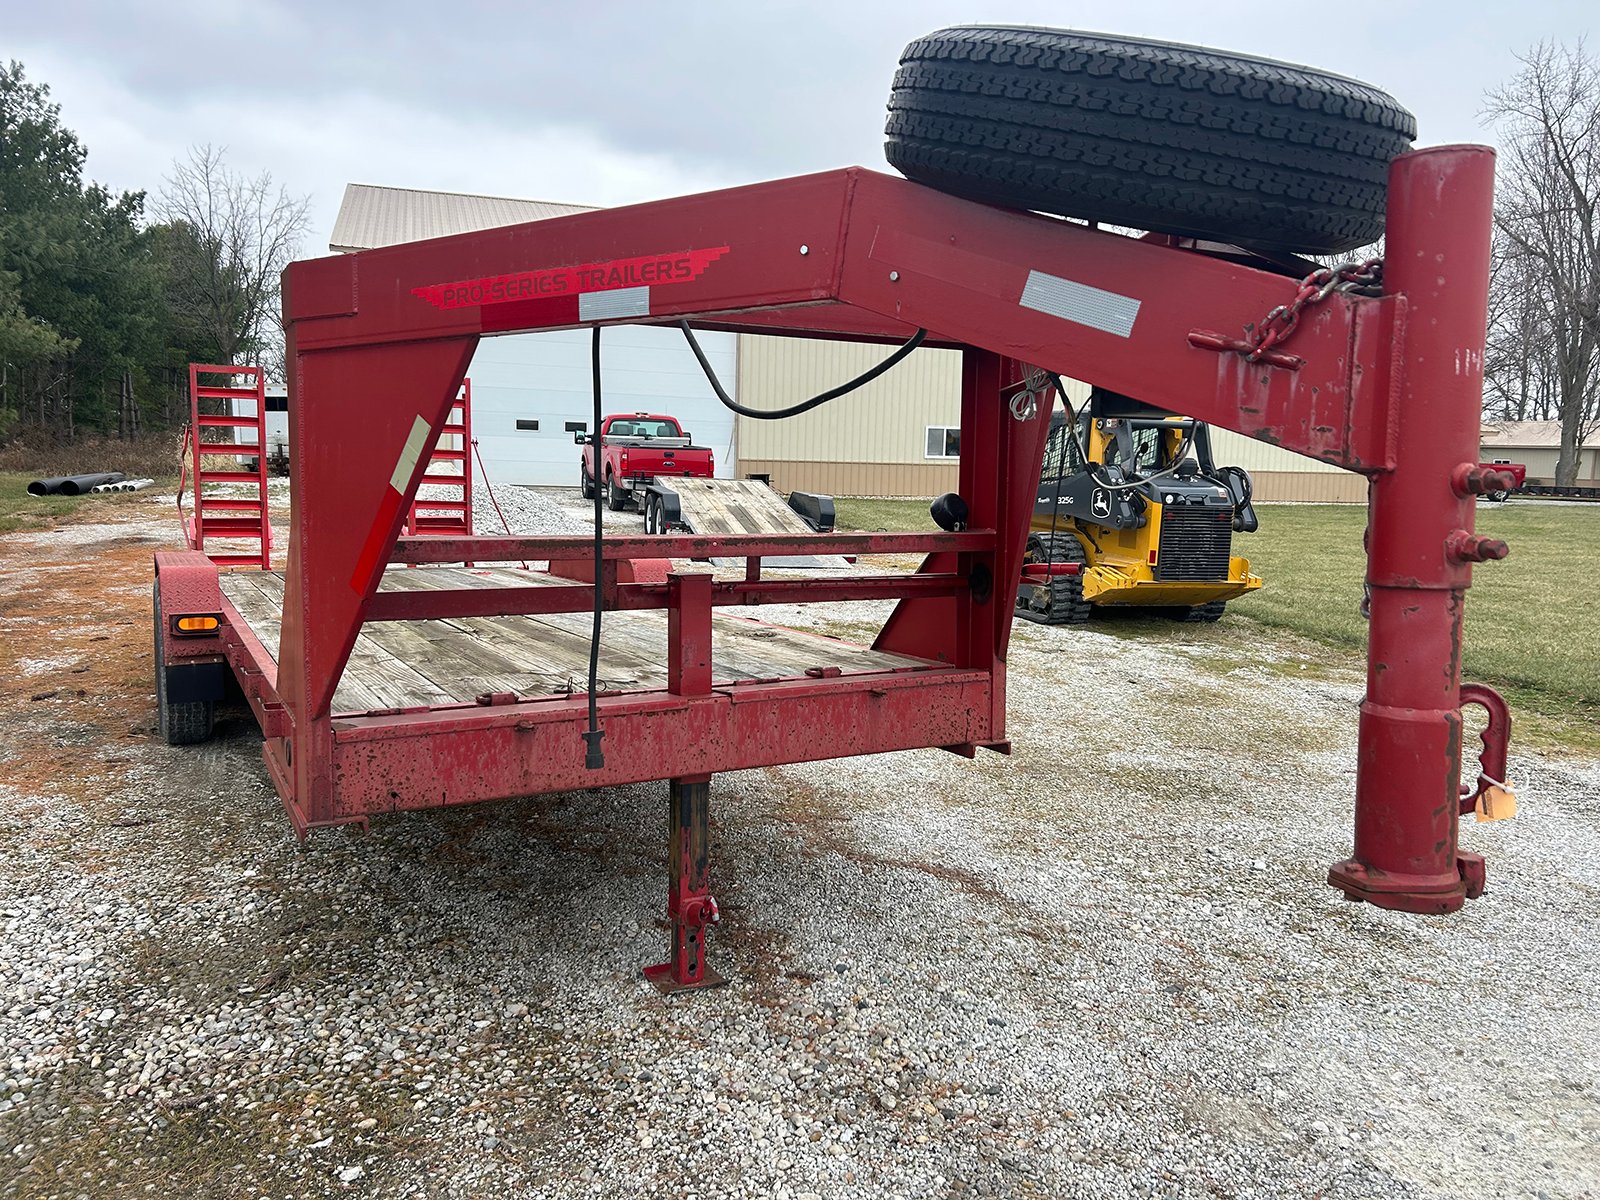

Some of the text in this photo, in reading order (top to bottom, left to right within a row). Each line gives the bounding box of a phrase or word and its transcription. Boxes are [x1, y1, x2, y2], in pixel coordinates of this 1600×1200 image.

[443, 258, 691, 305] PRO-SERIES TRAILERS
[1057, 496, 1074, 504] 325G
